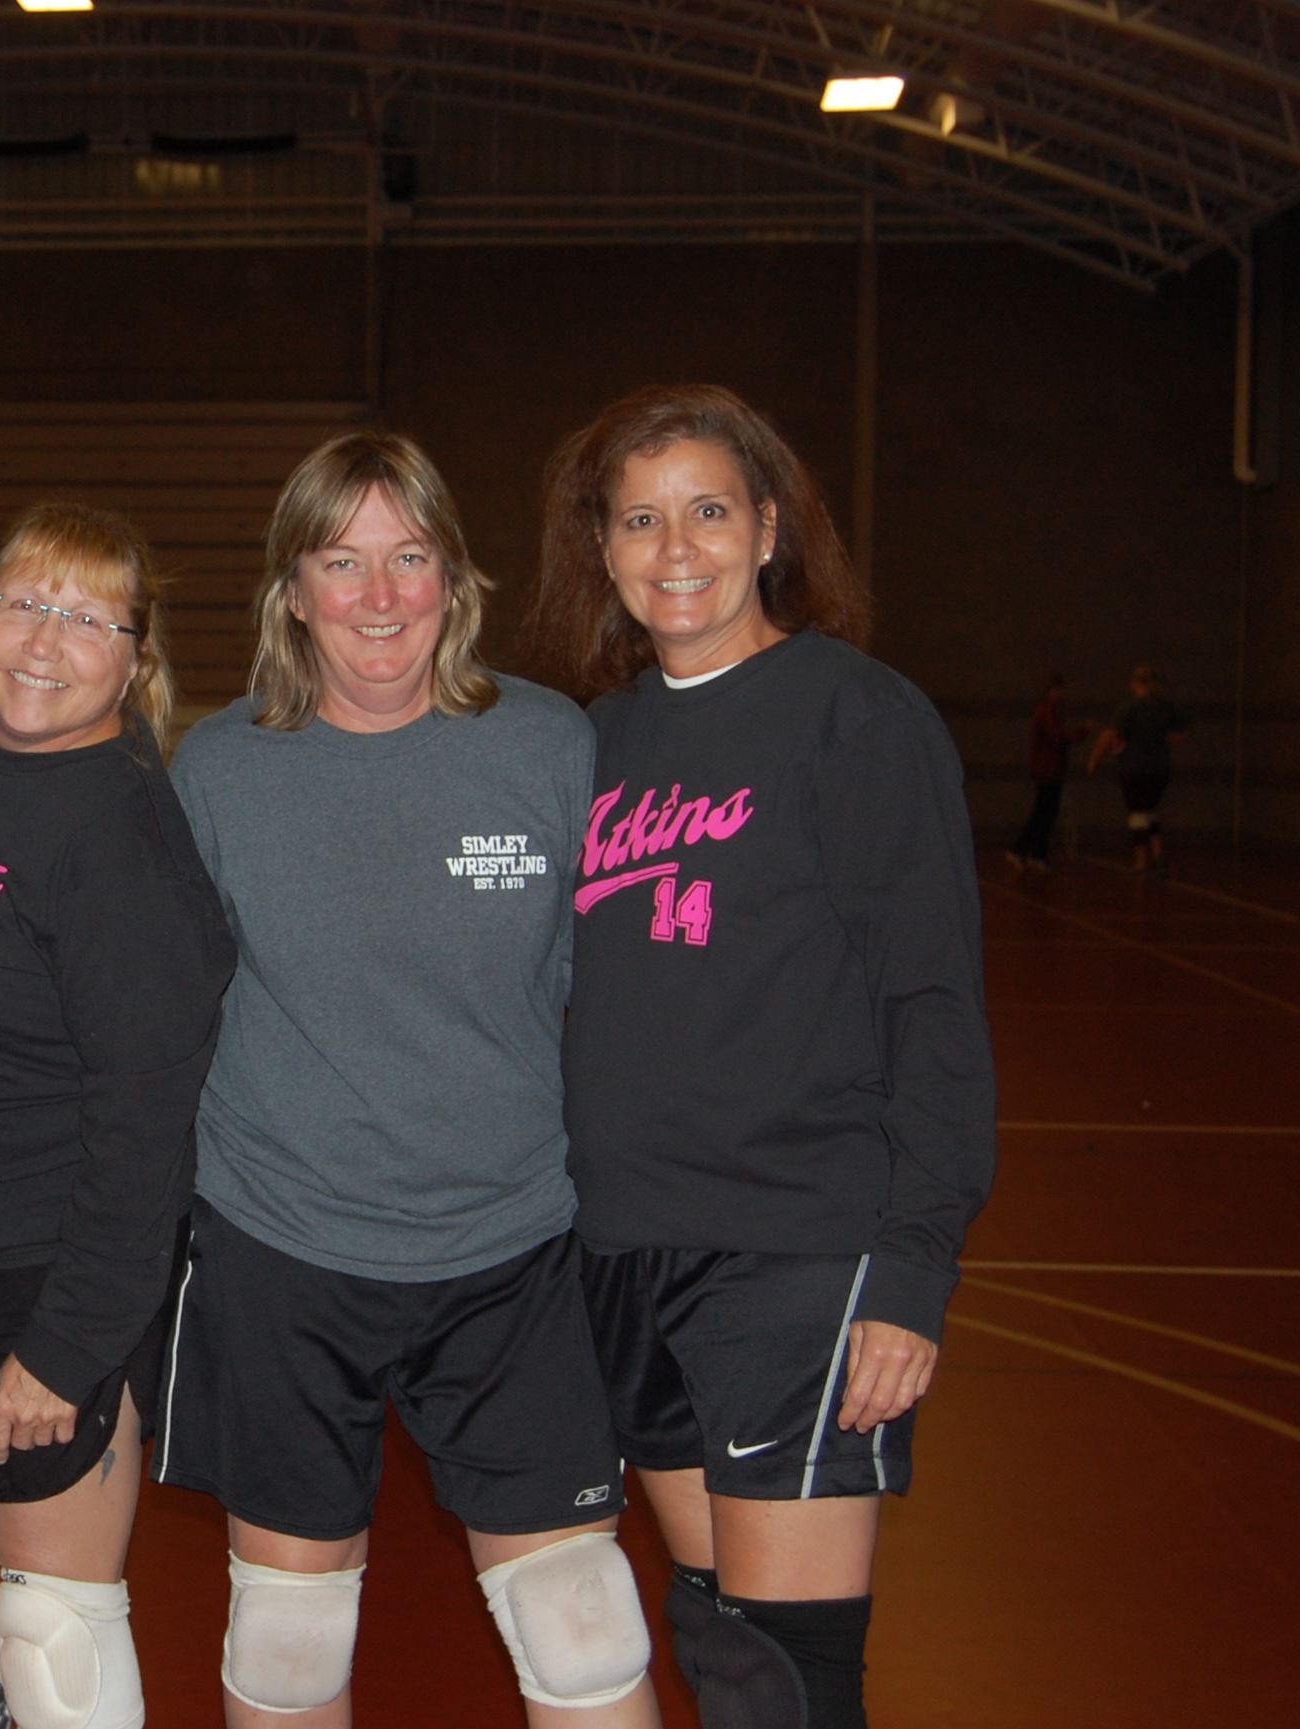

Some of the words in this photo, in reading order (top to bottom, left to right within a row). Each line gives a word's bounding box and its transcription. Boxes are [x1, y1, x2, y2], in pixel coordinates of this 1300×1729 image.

[461, 834, 528, 855] SIMLEY
[445, 855, 547, 877] WRESTLING
[473, 877, 496, 890] EST.
[500, 876, 525, 890] 1970
[650, 876, 713, 946] 14
